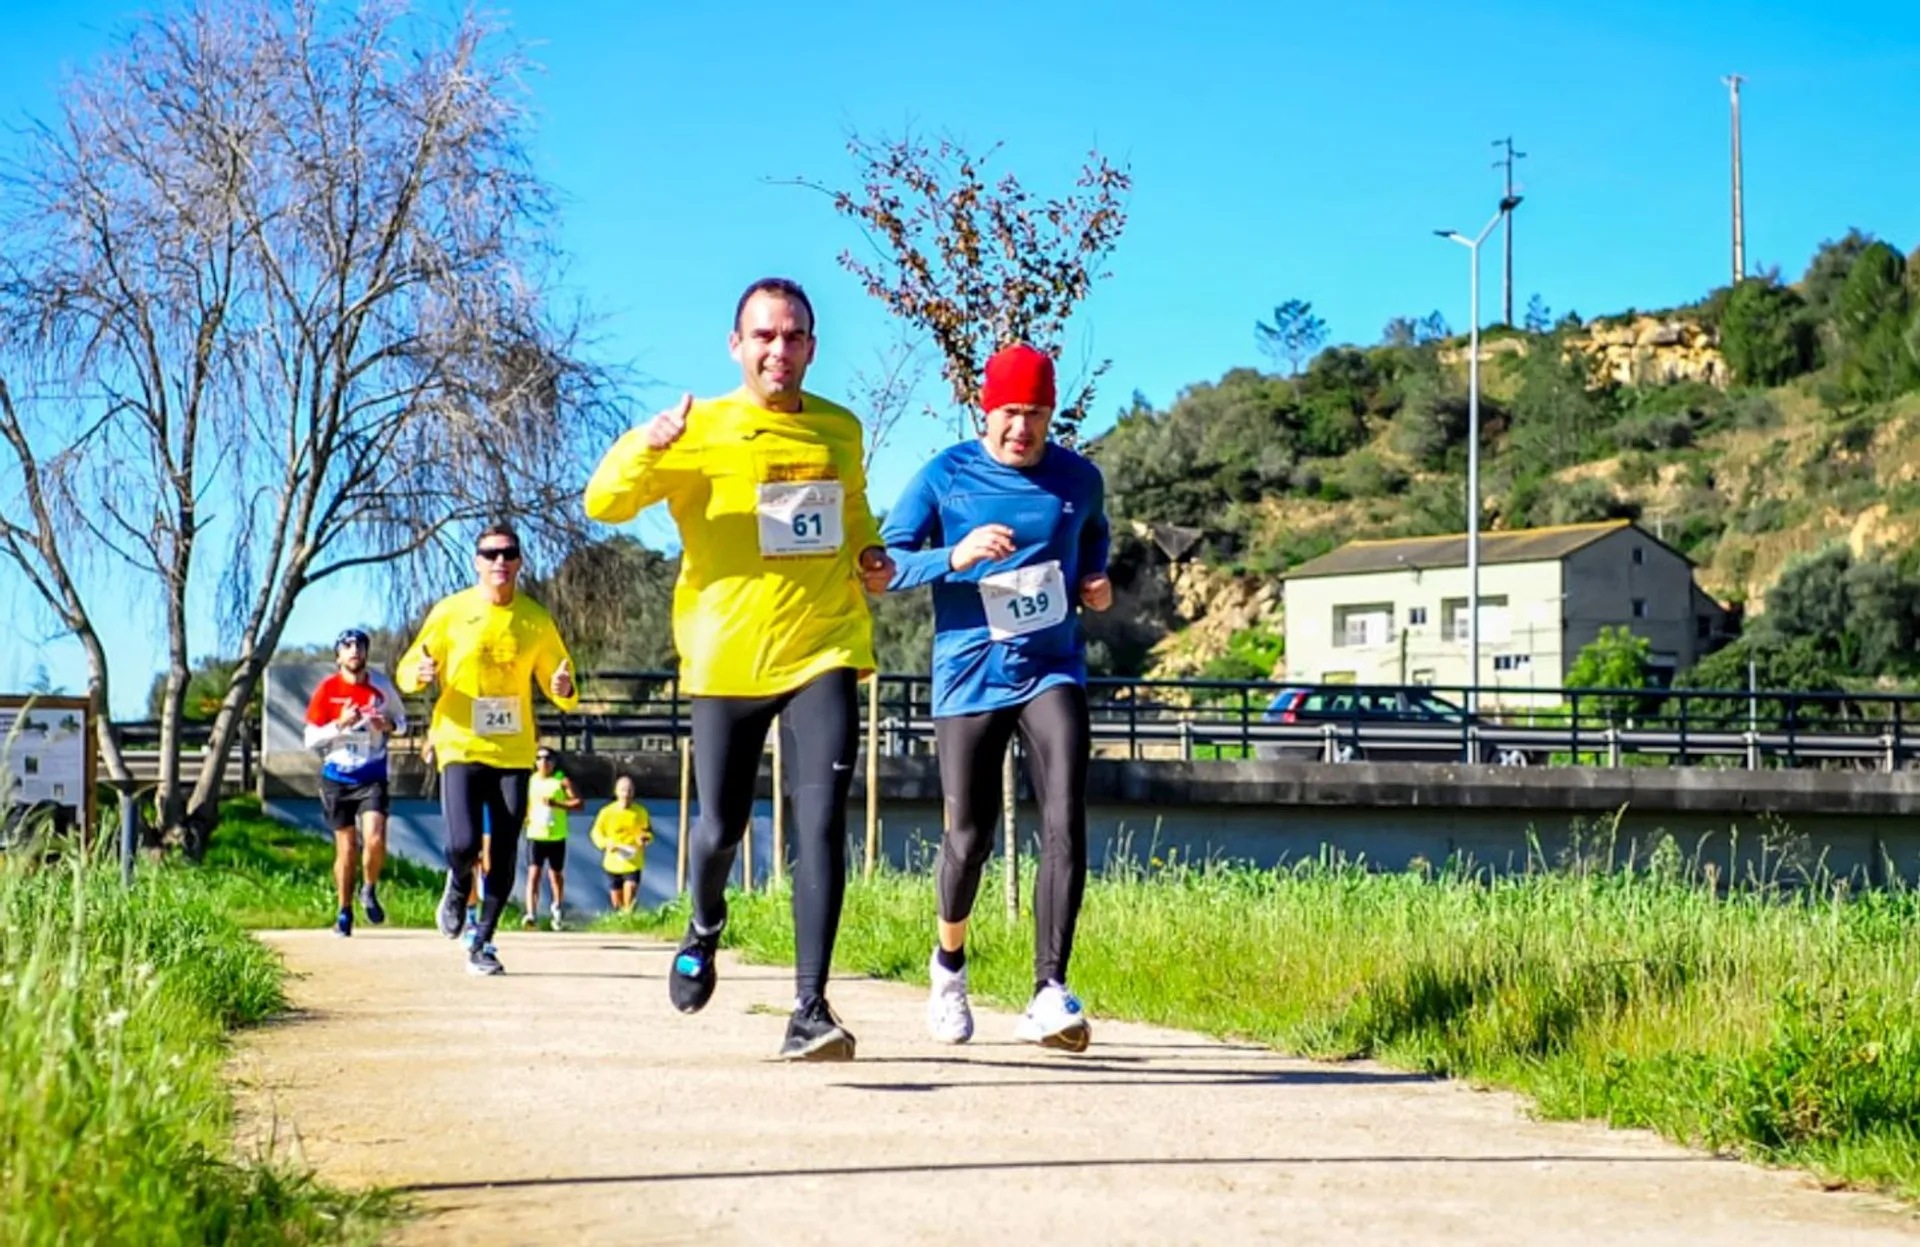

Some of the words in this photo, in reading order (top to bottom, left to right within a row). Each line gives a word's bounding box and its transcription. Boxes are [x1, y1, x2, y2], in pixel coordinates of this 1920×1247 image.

[793, 513, 822, 537] 61
[1006, 592, 1049, 619] 139
[486, 712, 511, 726] 241
